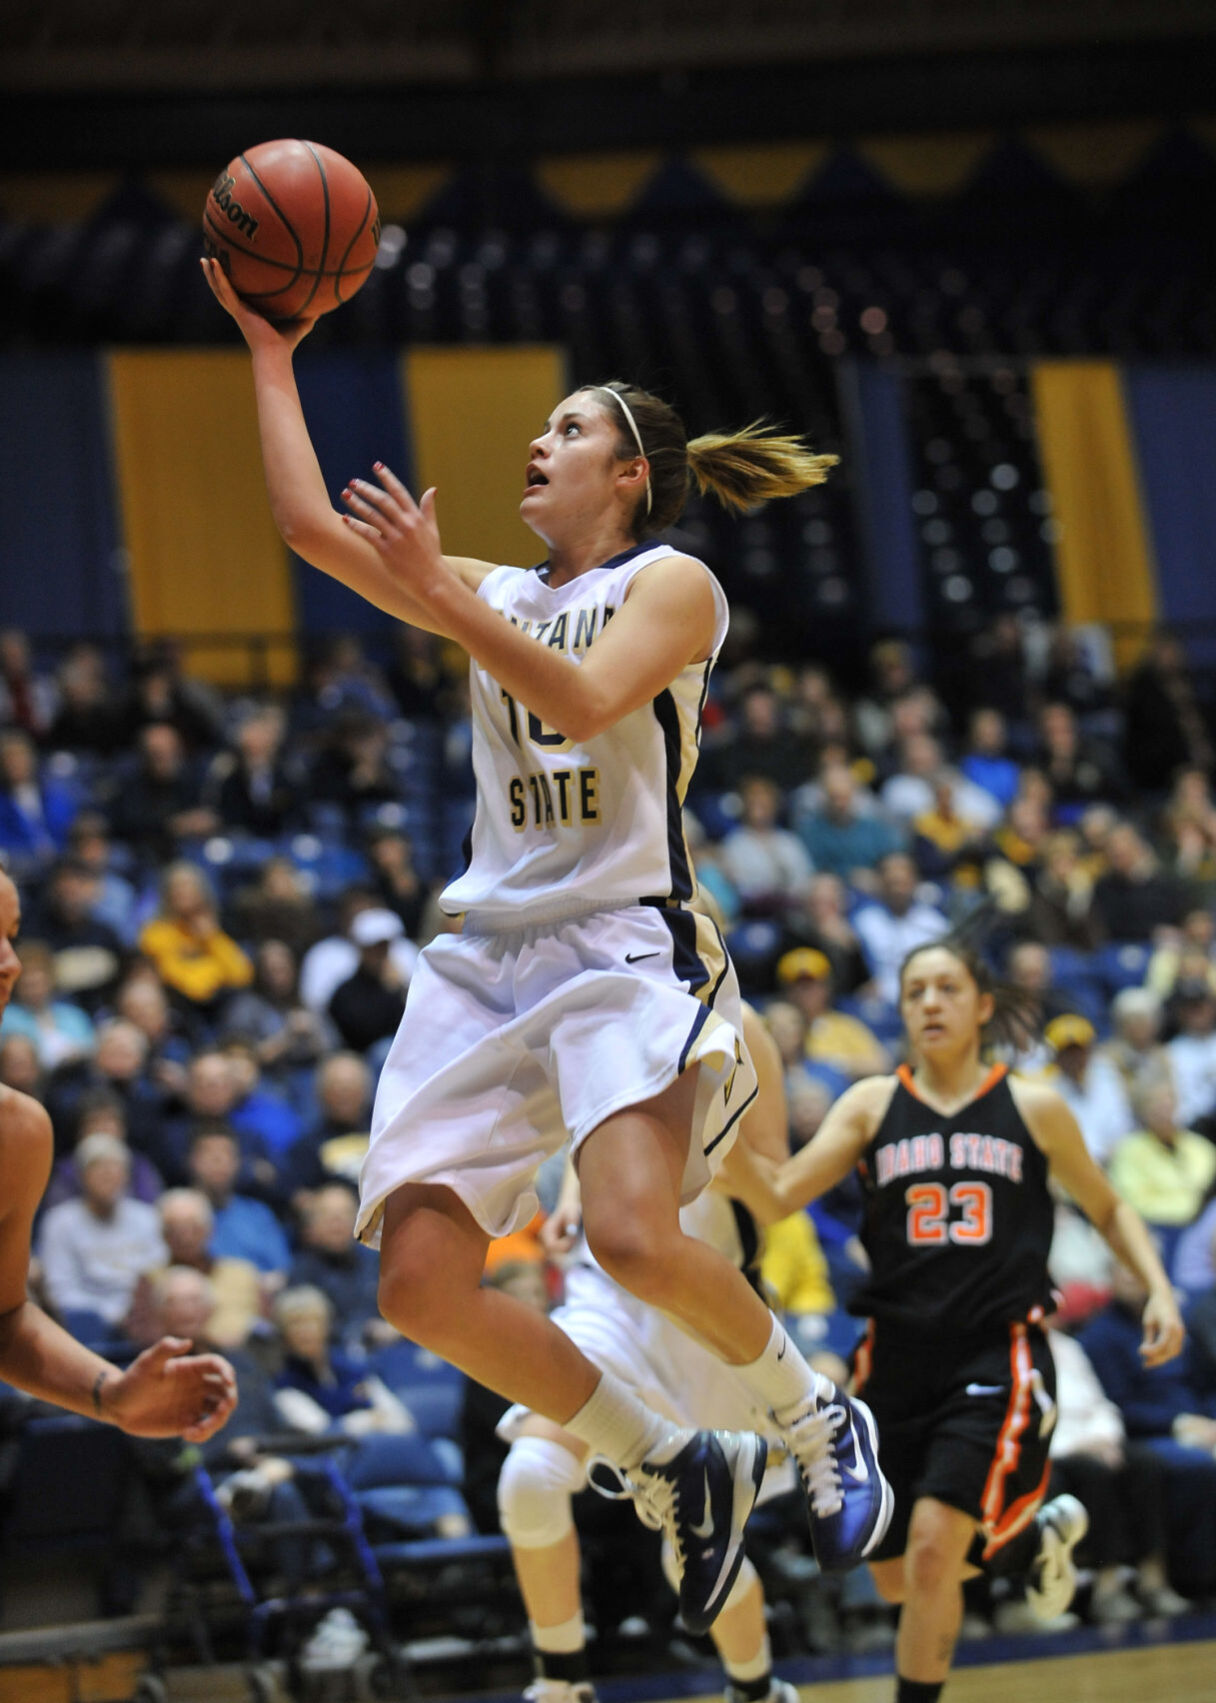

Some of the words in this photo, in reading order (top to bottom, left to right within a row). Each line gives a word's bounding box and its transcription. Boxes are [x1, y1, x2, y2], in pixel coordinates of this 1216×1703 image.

[509, 767, 602, 832] STATE
[875, 1132, 945, 1187] IDAHO
[949, 1132, 1024, 1184] STATE
[905, 1181, 993, 1246] 23
